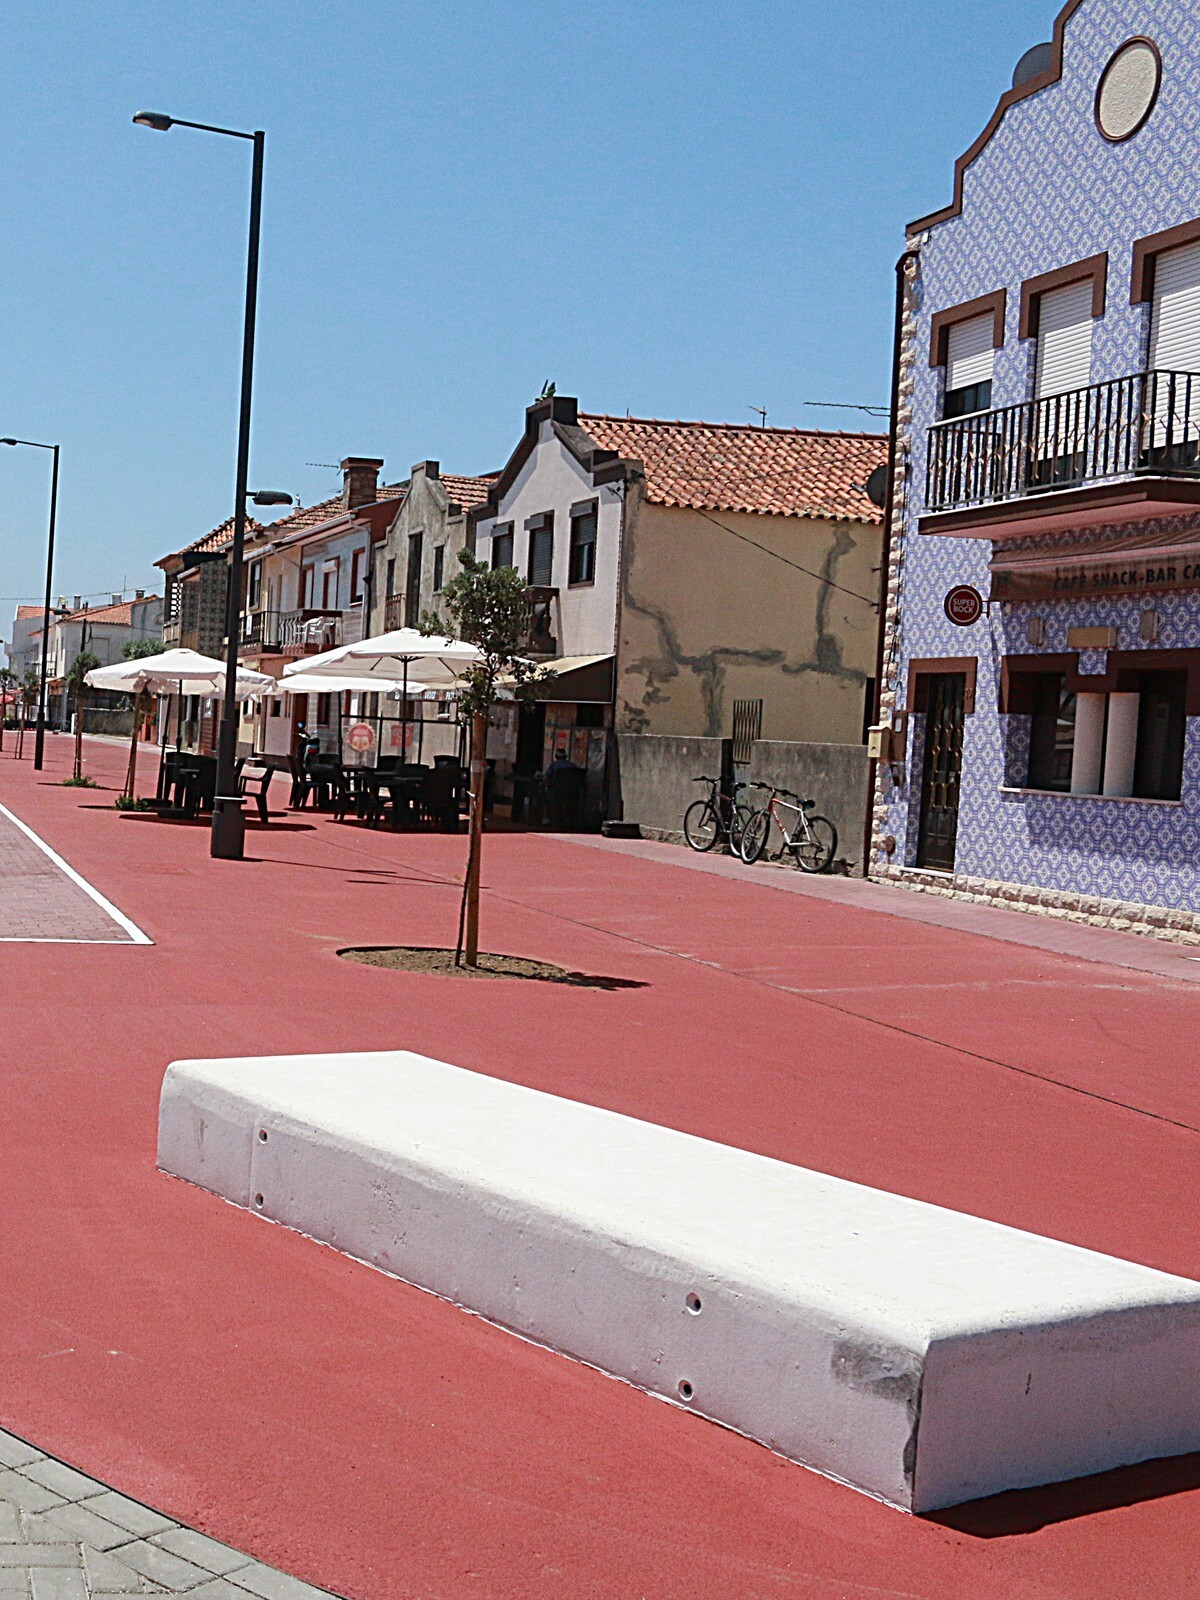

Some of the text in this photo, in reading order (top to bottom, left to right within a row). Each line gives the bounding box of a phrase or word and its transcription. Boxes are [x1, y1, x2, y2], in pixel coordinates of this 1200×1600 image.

[1092, 566, 1177, 588] SNACK-BAR
[952, 598, 975, 607] SUPER
[953, 605, 974, 614] BOCK
